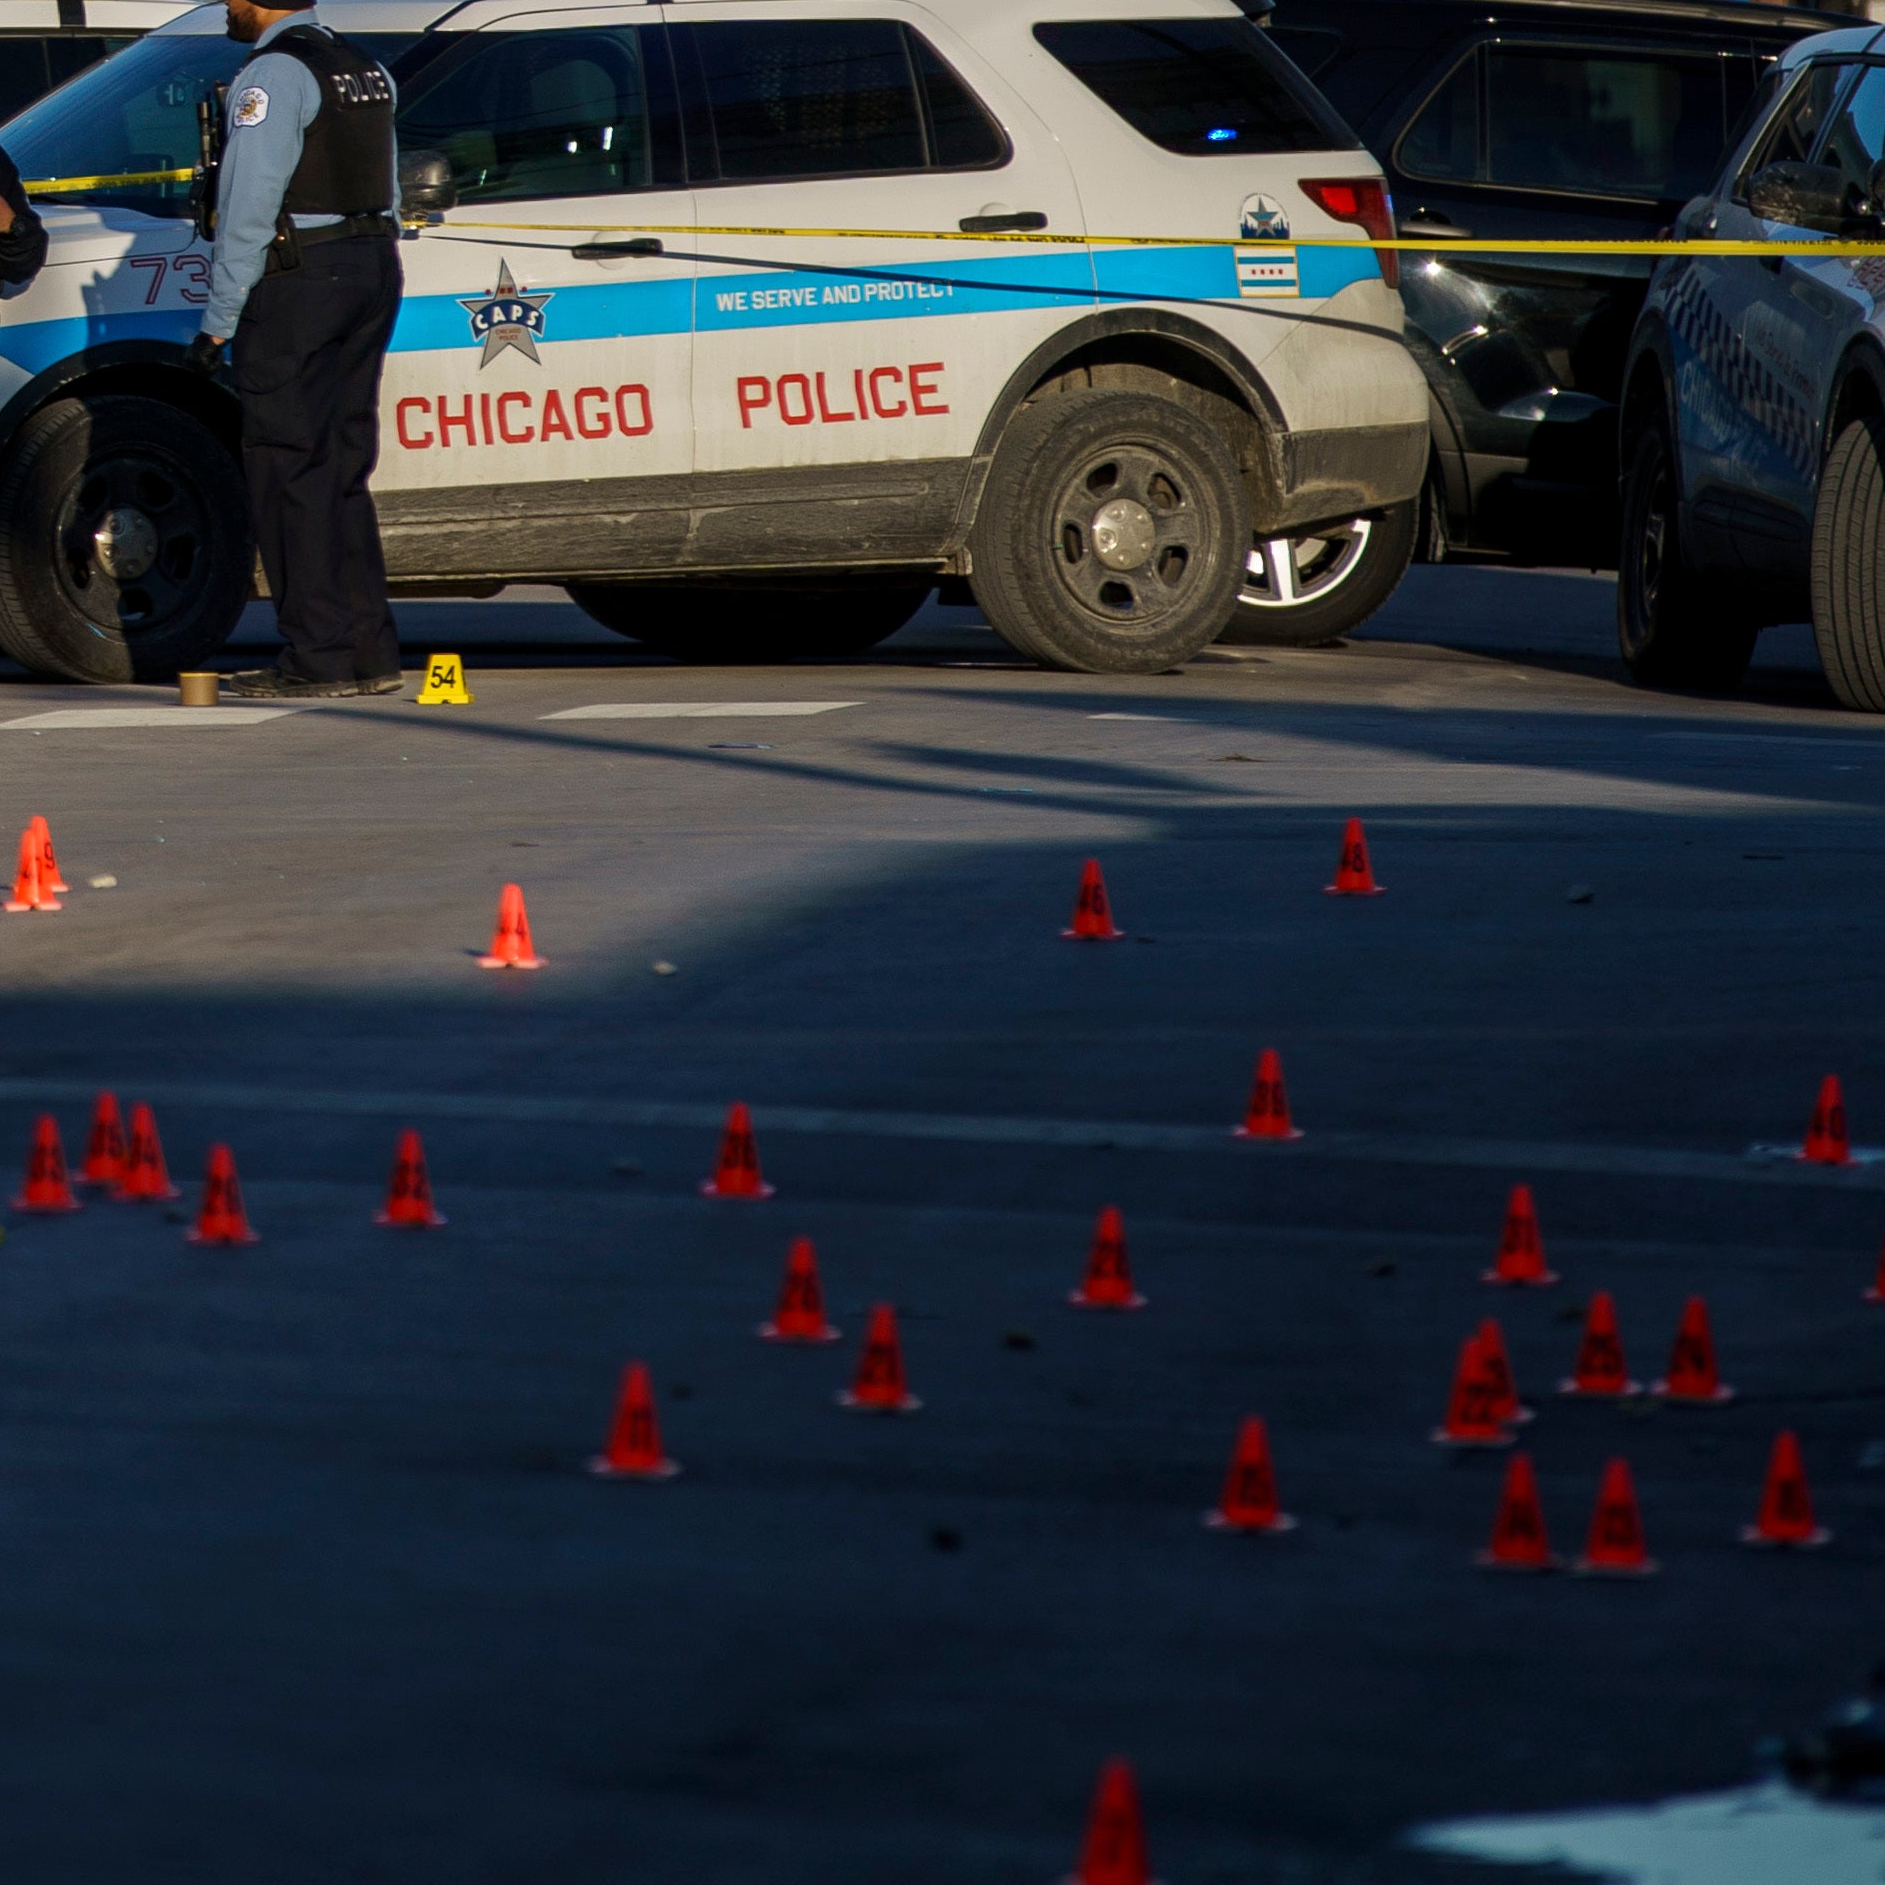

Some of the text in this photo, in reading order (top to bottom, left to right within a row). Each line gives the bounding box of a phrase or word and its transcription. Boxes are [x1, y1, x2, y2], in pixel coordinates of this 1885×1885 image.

[130, 253, 212, 305] 73
[715, 278, 956, 312] WE SERVE AND PROTECT
[475, 304, 540, 330] CAPS
[396, 361, 951, 450] CHICAGO POLICE
[430, 664, 456, 689] 54
